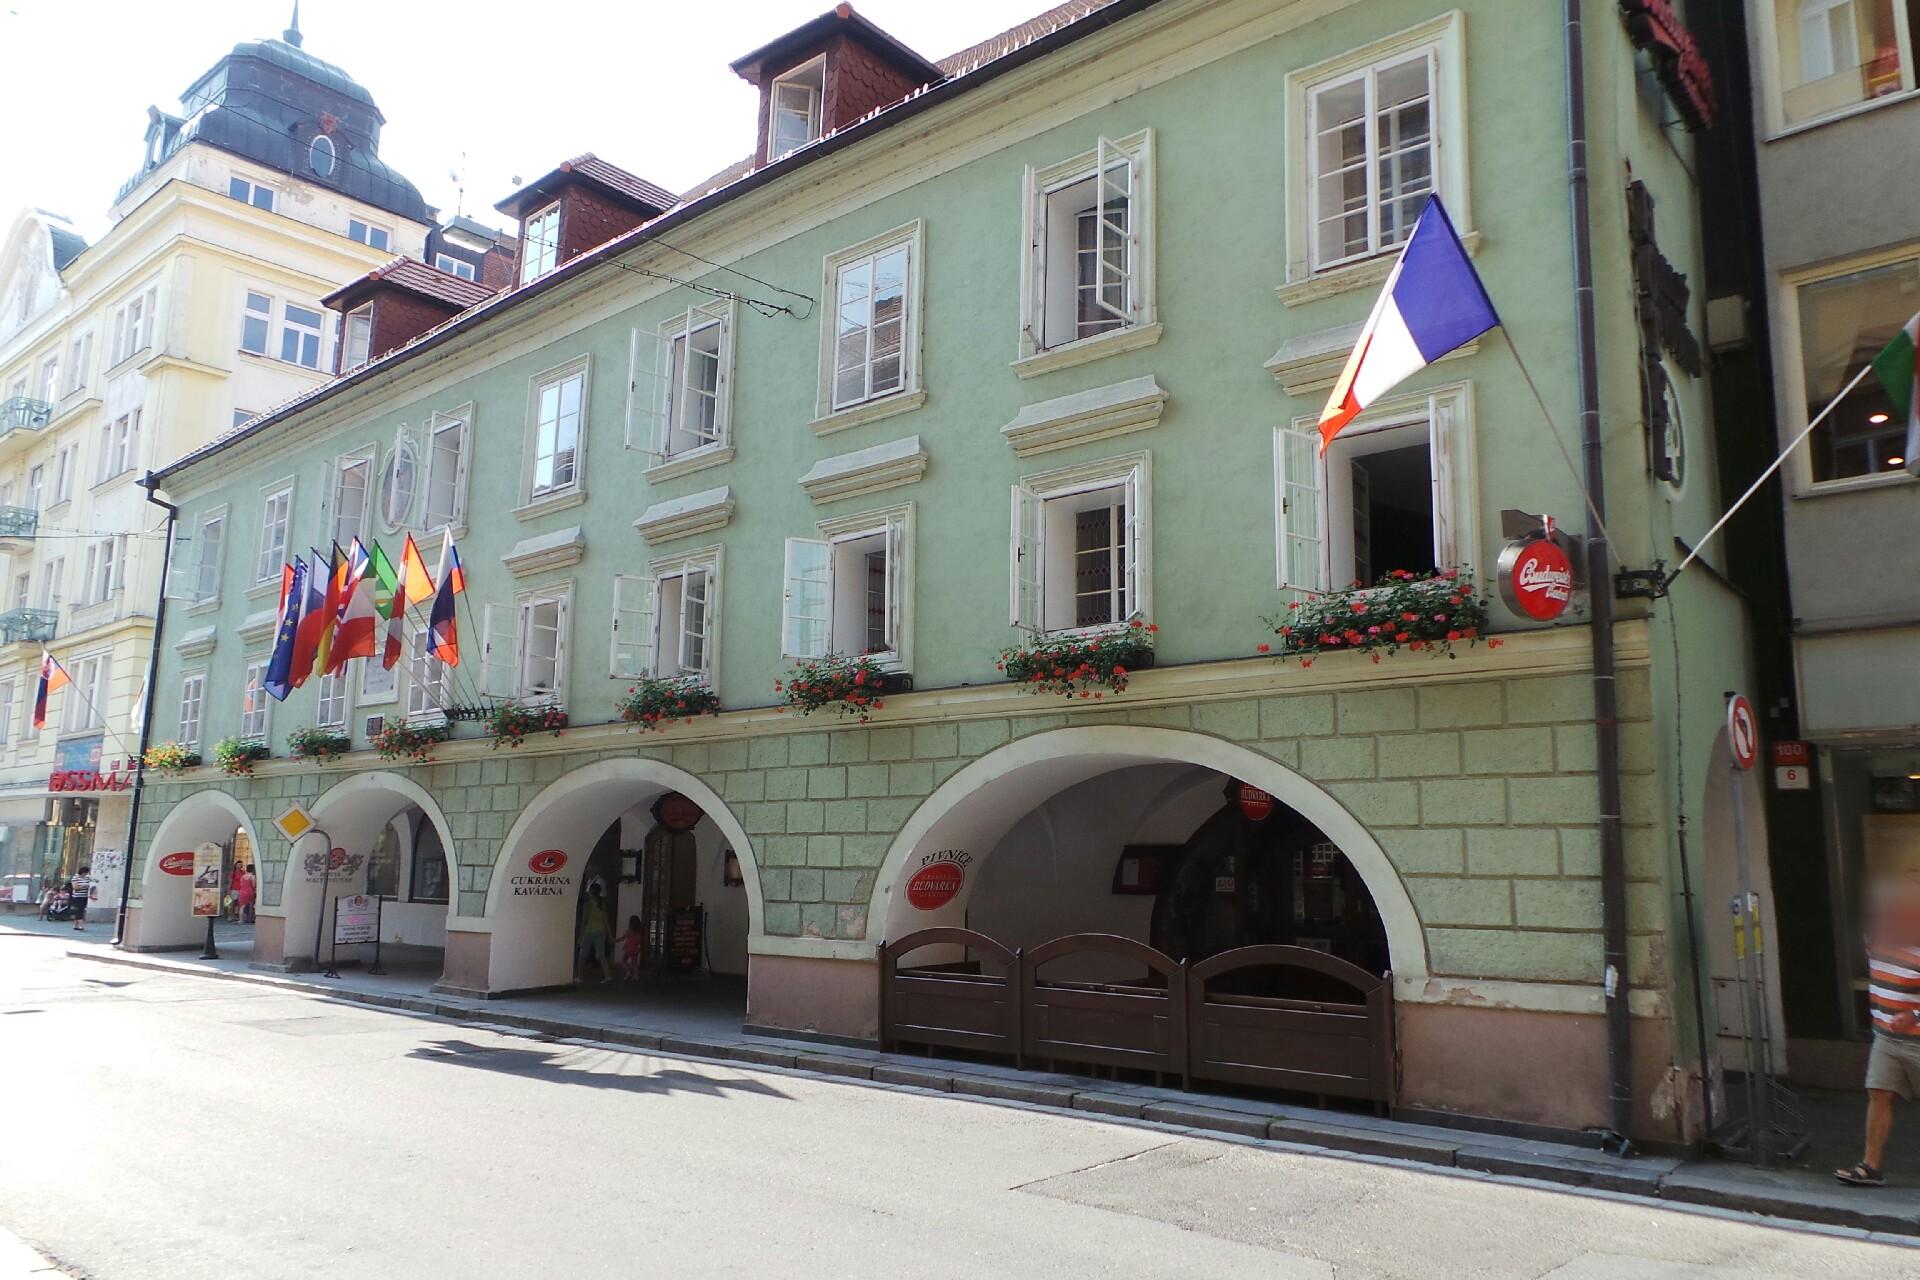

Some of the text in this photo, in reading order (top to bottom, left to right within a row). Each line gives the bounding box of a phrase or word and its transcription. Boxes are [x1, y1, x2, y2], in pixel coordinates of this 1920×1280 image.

[1787, 769, 1796, 781] 6
[921, 849, 973, 868] PIVNICE
[511, 876, 570, 885] CUKRÁRNA
[514, 886, 562, 895] KAVÁRNA
[912, 881, 956, 891] BUDVARKA
